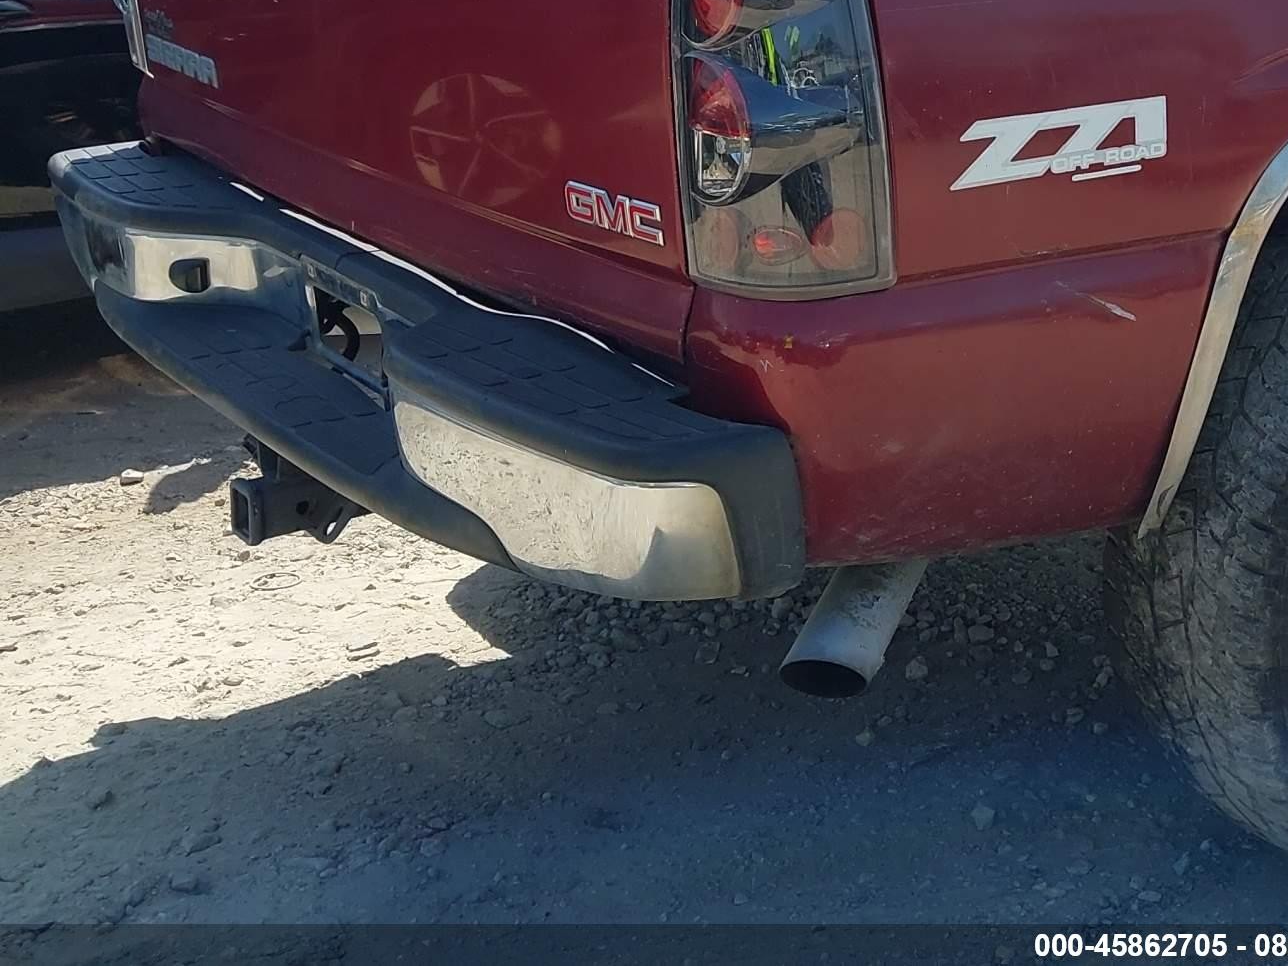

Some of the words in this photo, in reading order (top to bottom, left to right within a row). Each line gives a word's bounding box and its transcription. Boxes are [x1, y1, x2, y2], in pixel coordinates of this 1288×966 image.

[949, 95, 1167, 192] Z71
[1050, 151, 1098, 174] OFF
[1103, 142, 1167, 165] ROAD
[564, 180, 665, 247] GMC
